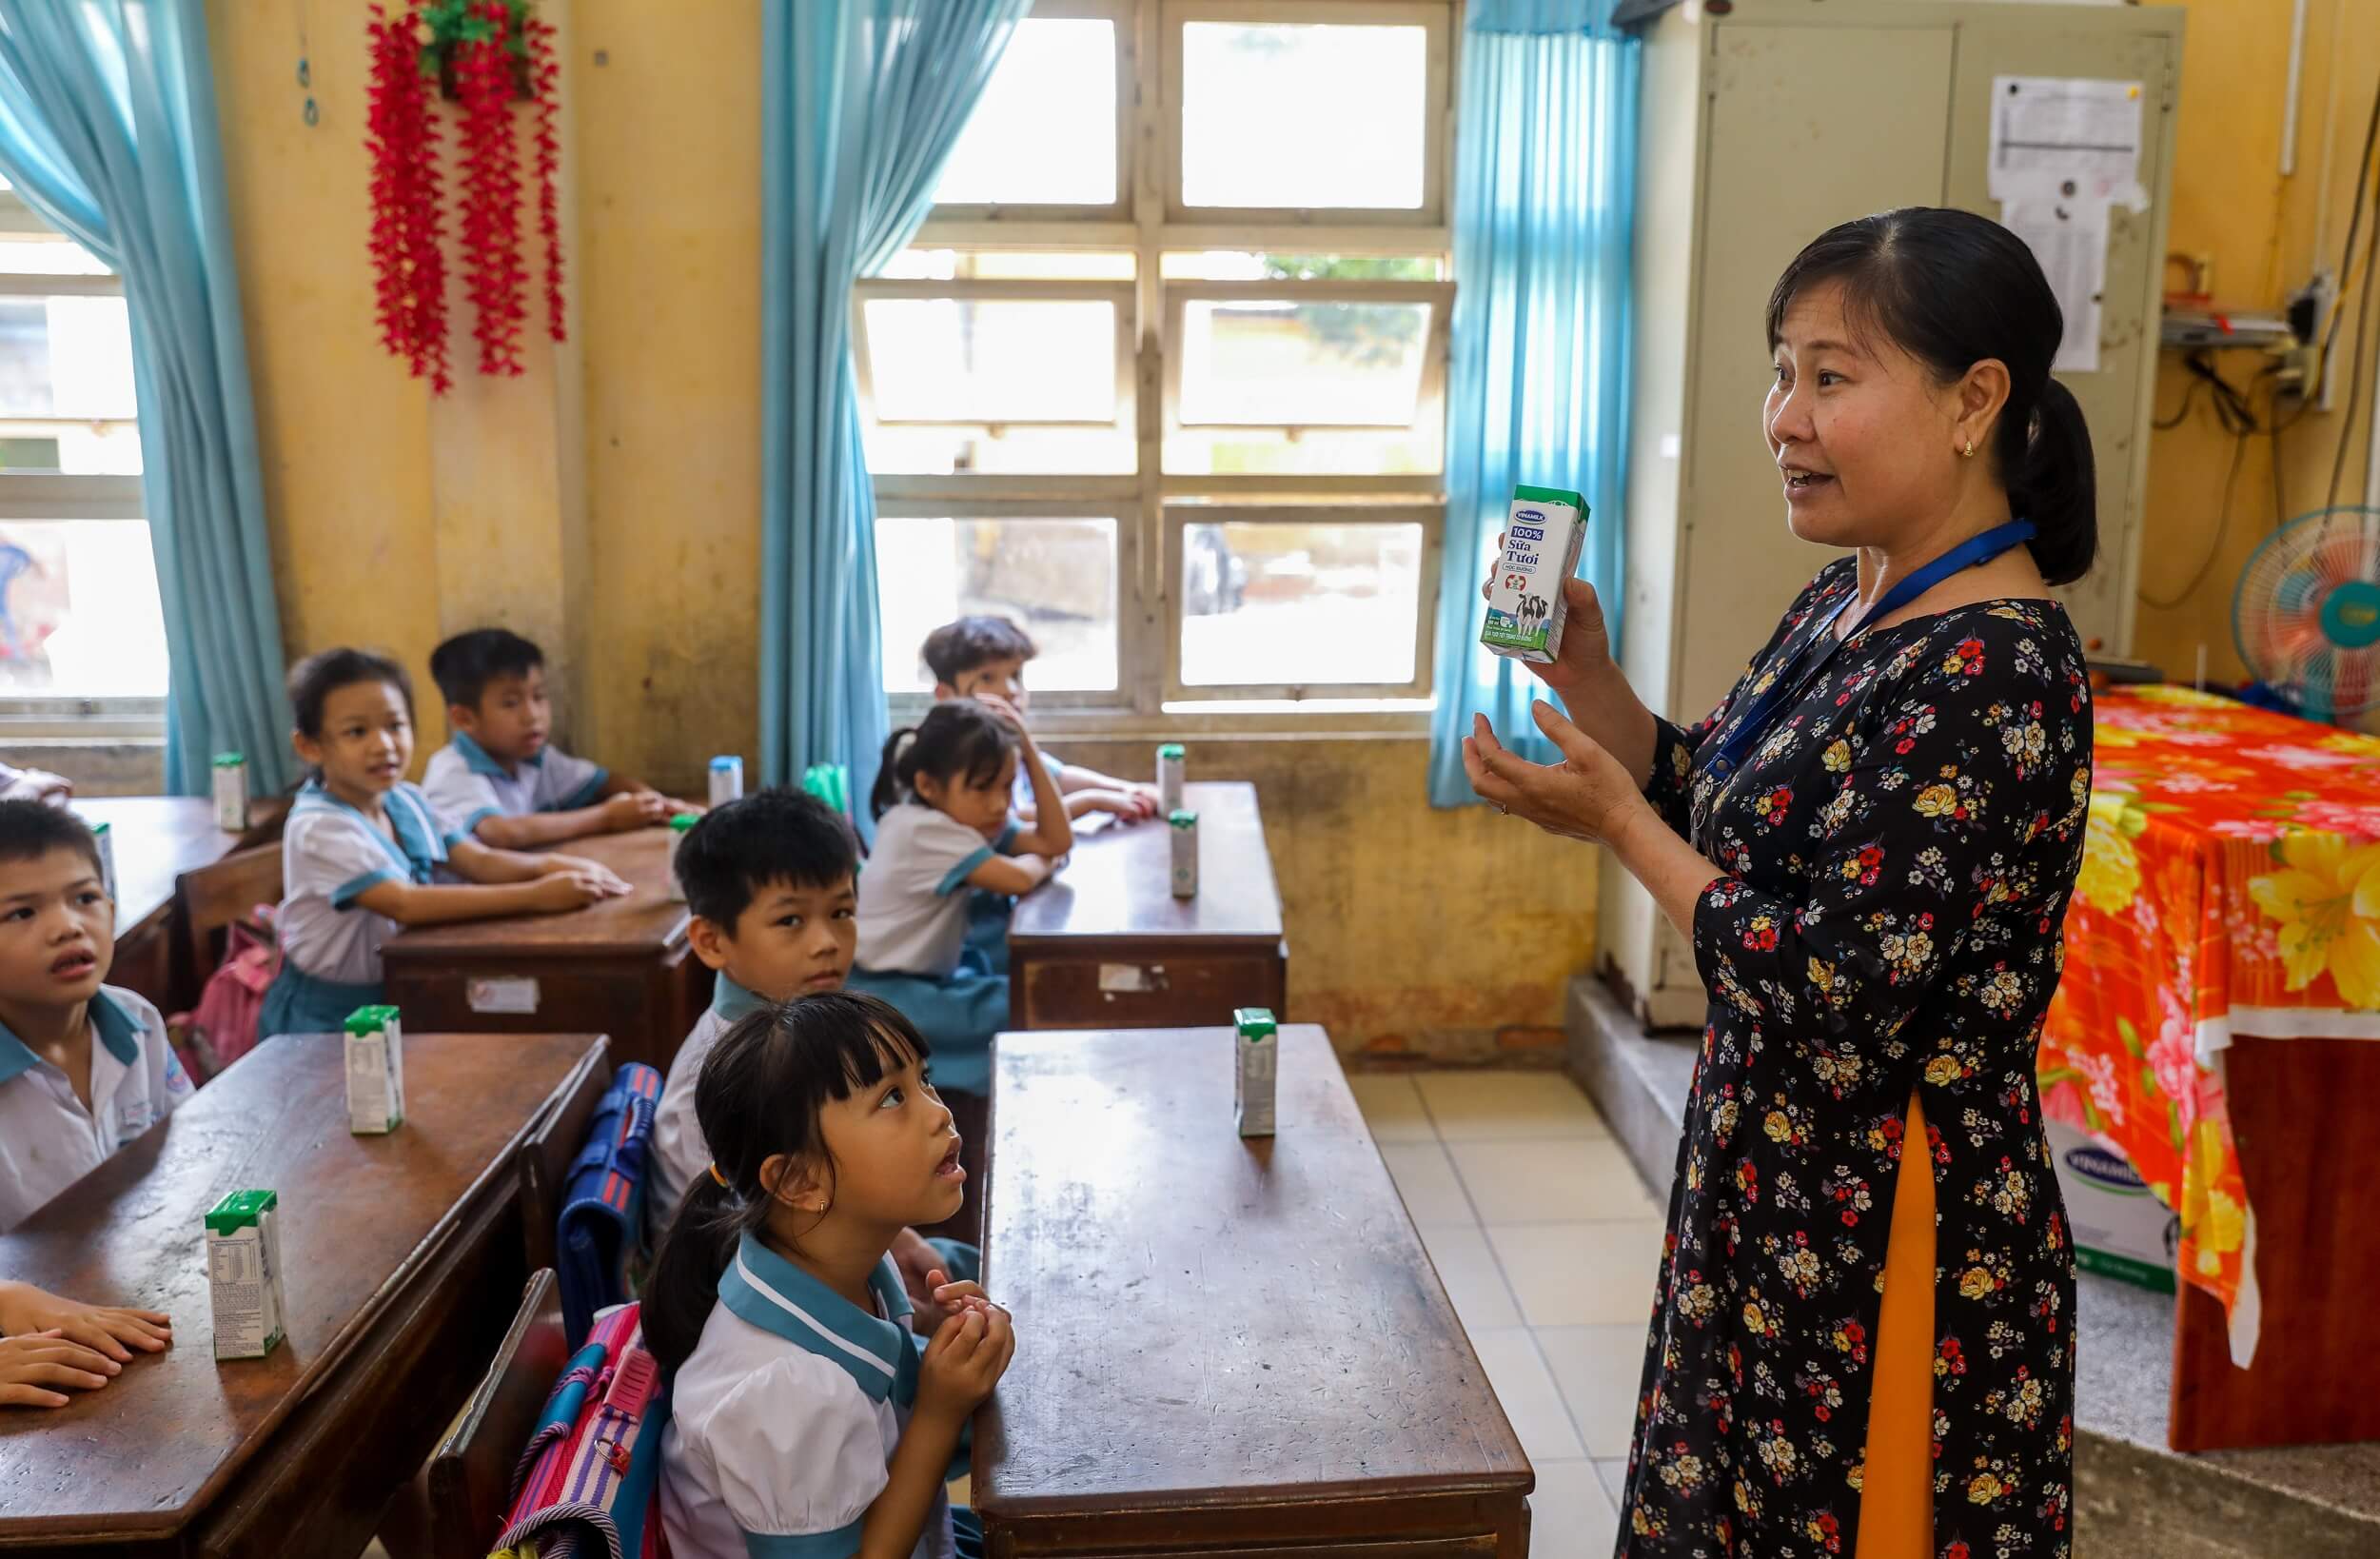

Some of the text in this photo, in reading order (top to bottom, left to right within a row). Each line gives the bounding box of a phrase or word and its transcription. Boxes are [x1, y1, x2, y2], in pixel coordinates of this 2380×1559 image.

[1518, 512, 1544, 521] VINAMILK
[1513, 527, 1542, 540] 100%
[1508, 540, 1531, 551] Sữa
[1506, 550, 1539, 565] Tươi
[2071, 1154, 2139, 1184] VINAMIL
